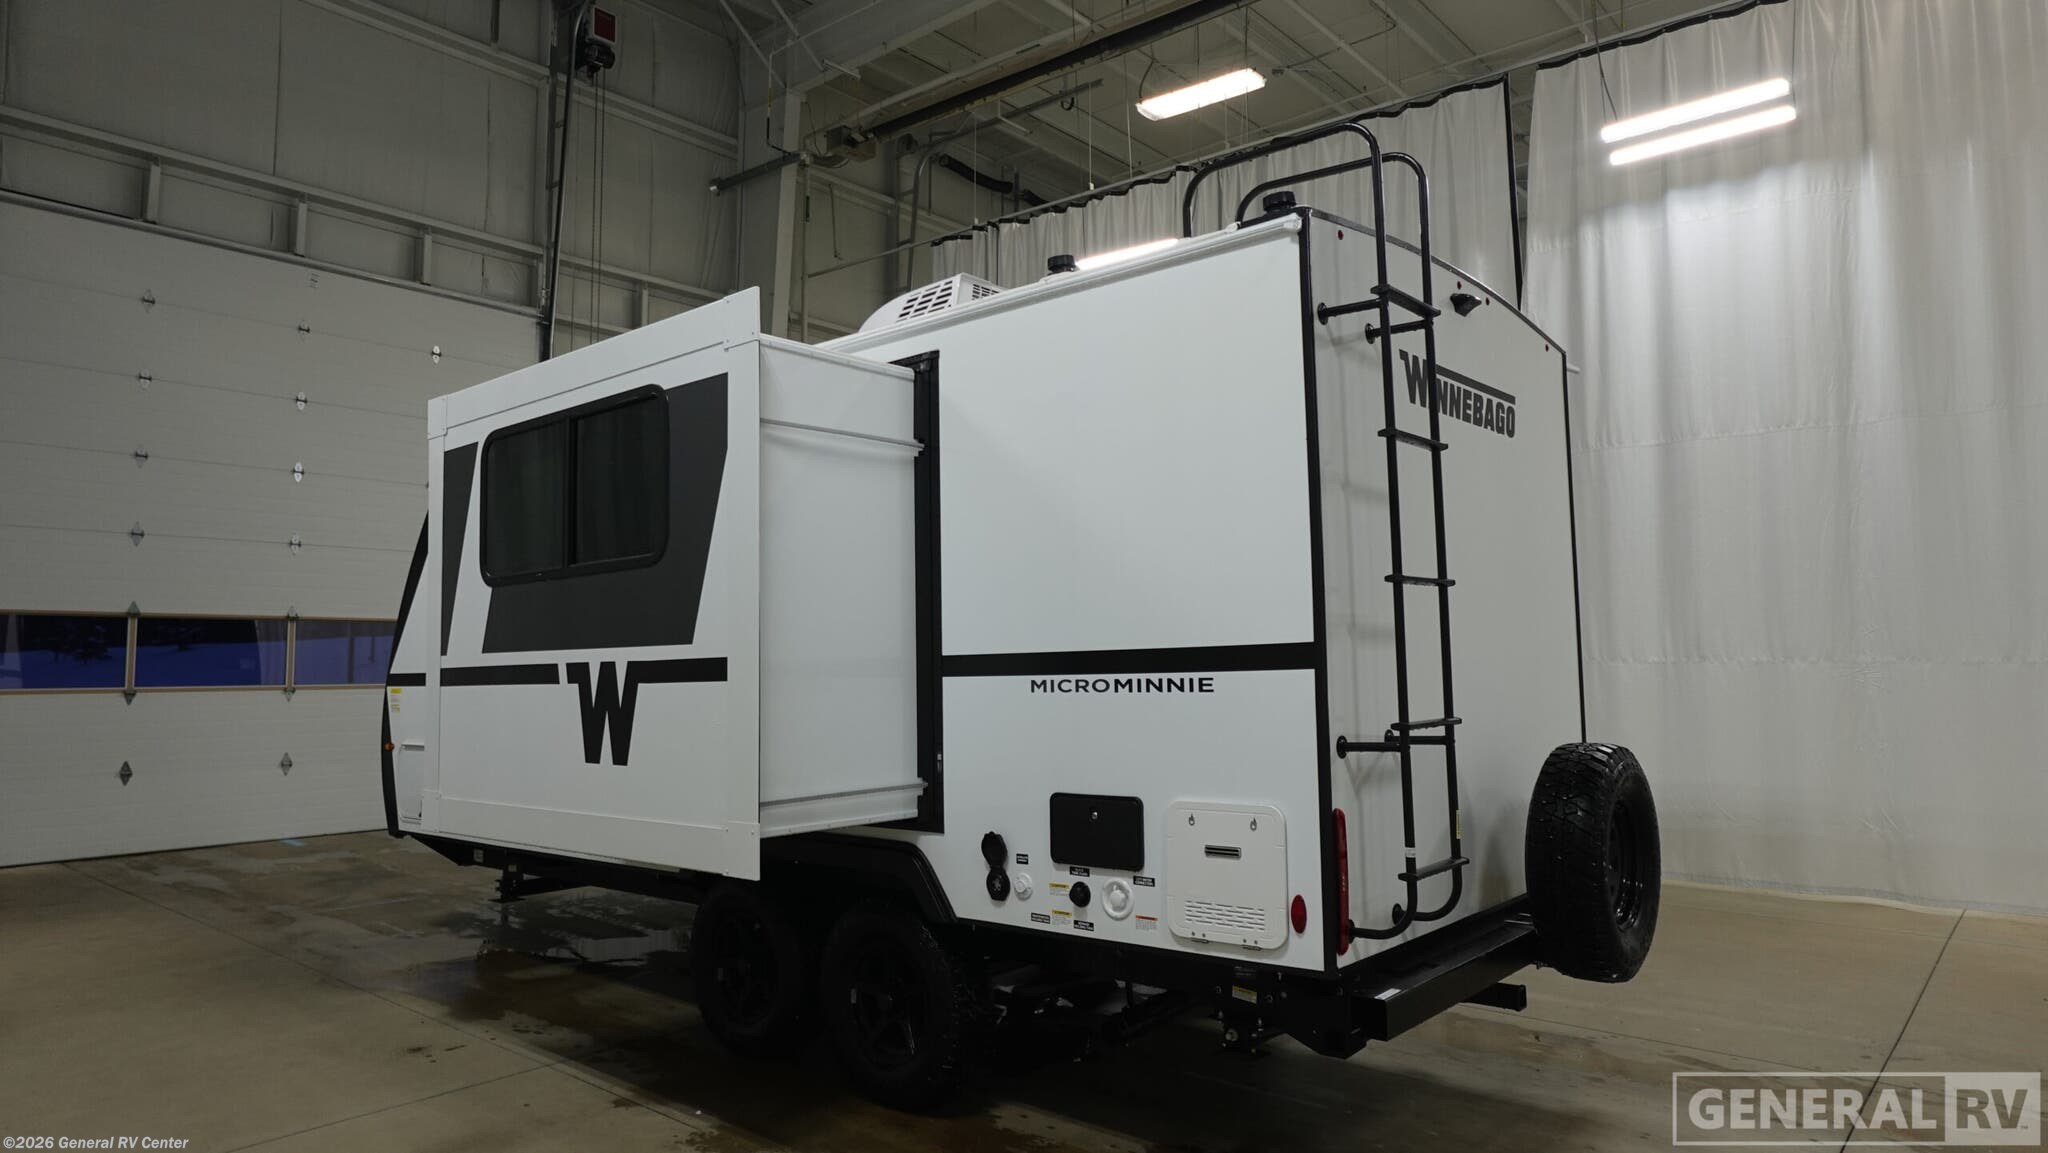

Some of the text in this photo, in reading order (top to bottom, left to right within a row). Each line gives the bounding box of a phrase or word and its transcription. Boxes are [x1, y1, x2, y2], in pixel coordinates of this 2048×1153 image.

[1399, 348, 1516, 438] WNNEBAGO
[565, 660, 640, 767] W
[1030, 677, 1214, 694] MICROMINNIE
